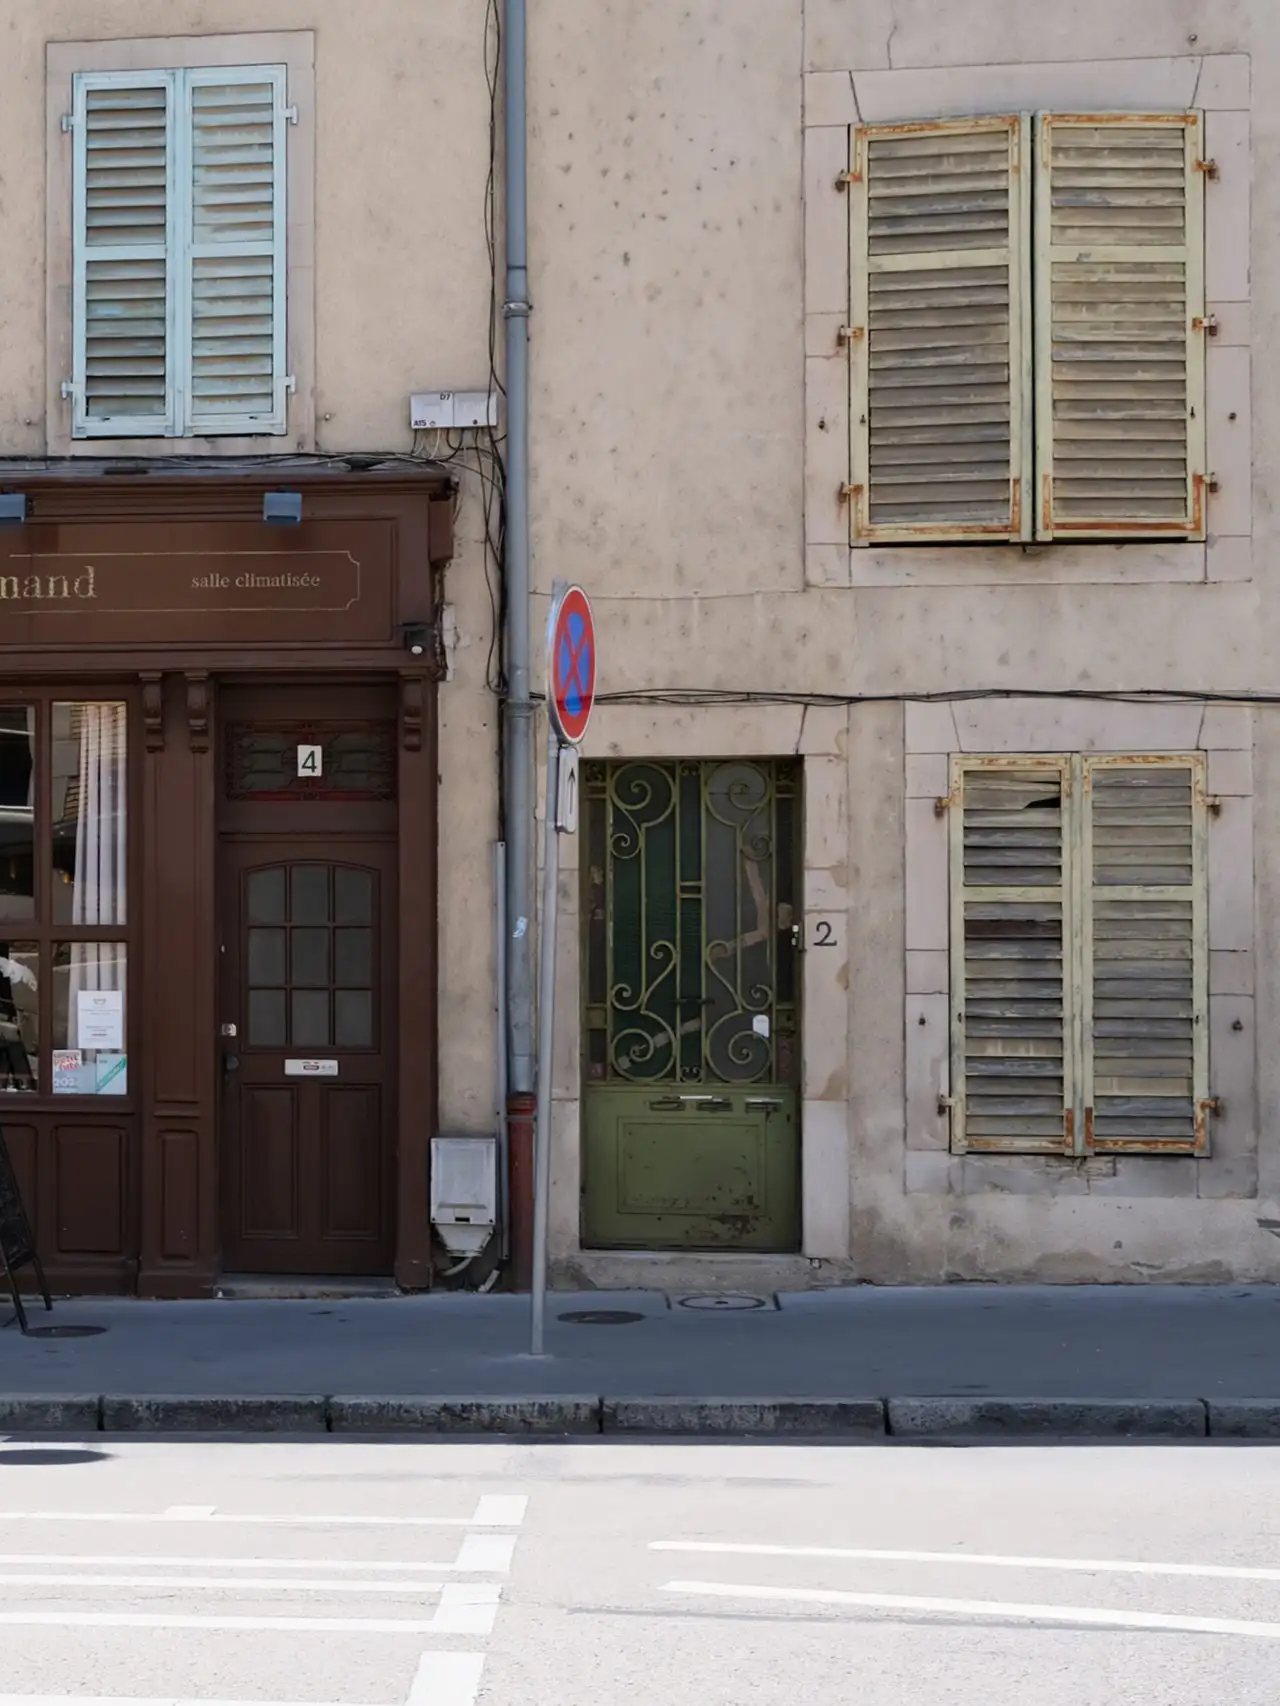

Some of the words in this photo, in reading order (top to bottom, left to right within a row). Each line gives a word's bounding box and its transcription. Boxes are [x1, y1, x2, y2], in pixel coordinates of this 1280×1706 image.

[191, 572, 230, 589] salle
[235, 571, 321, 588] climatisée
[301, 749, 318, 774] 4
[812, 920, 838, 947] 2
